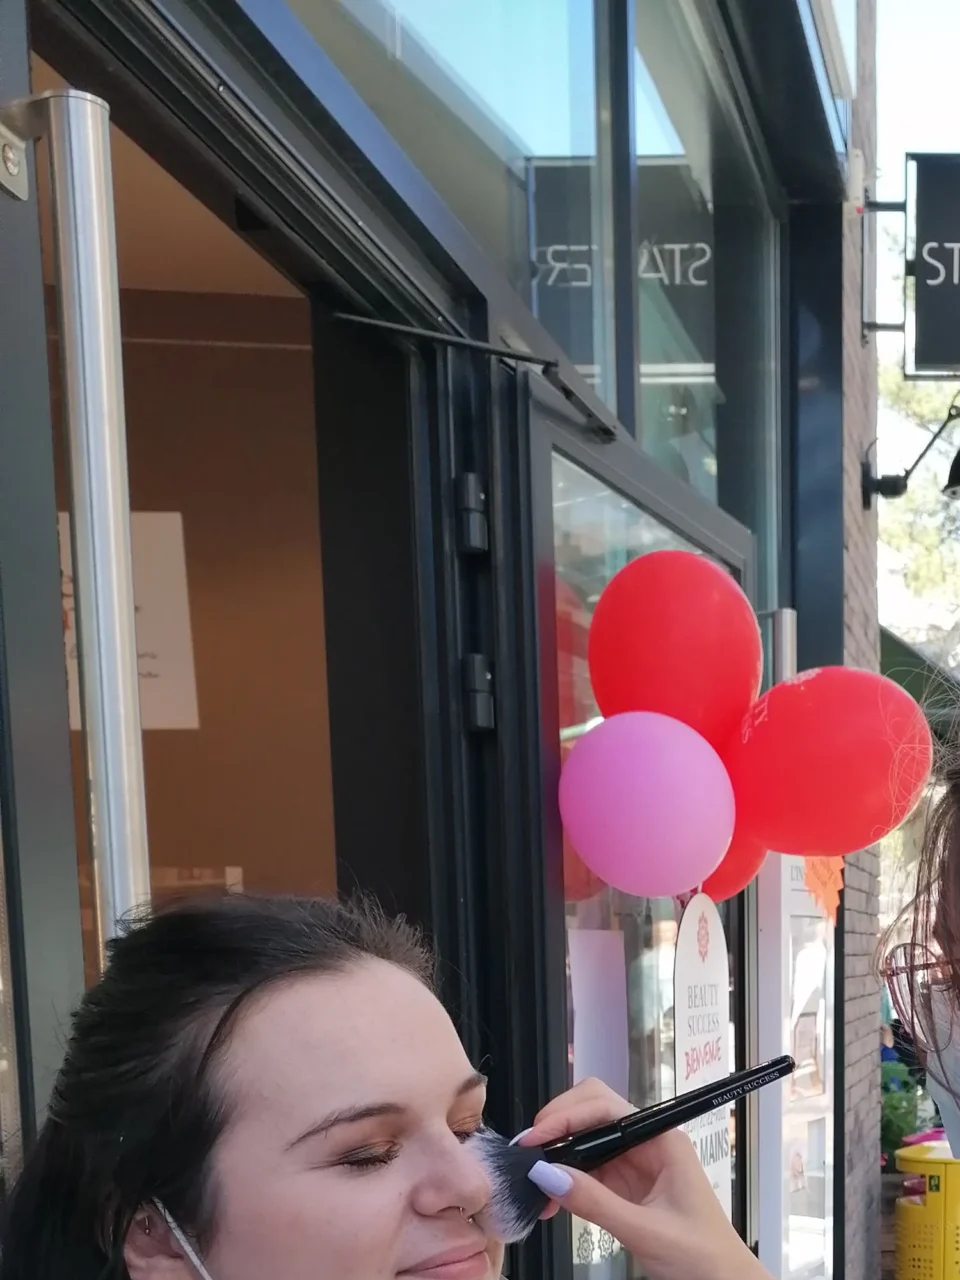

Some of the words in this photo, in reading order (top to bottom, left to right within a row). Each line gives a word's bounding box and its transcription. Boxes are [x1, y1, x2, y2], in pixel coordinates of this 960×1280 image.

[687, 984, 718, 1009] BEAUTY
[687, 1012, 720, 1037] SUCCESS
[712, 1087, 743, 1106] BEAUTY
[743, 1070, 780, 1092] SUCCESS
[700, 1127, 729, 1169] MAINS
